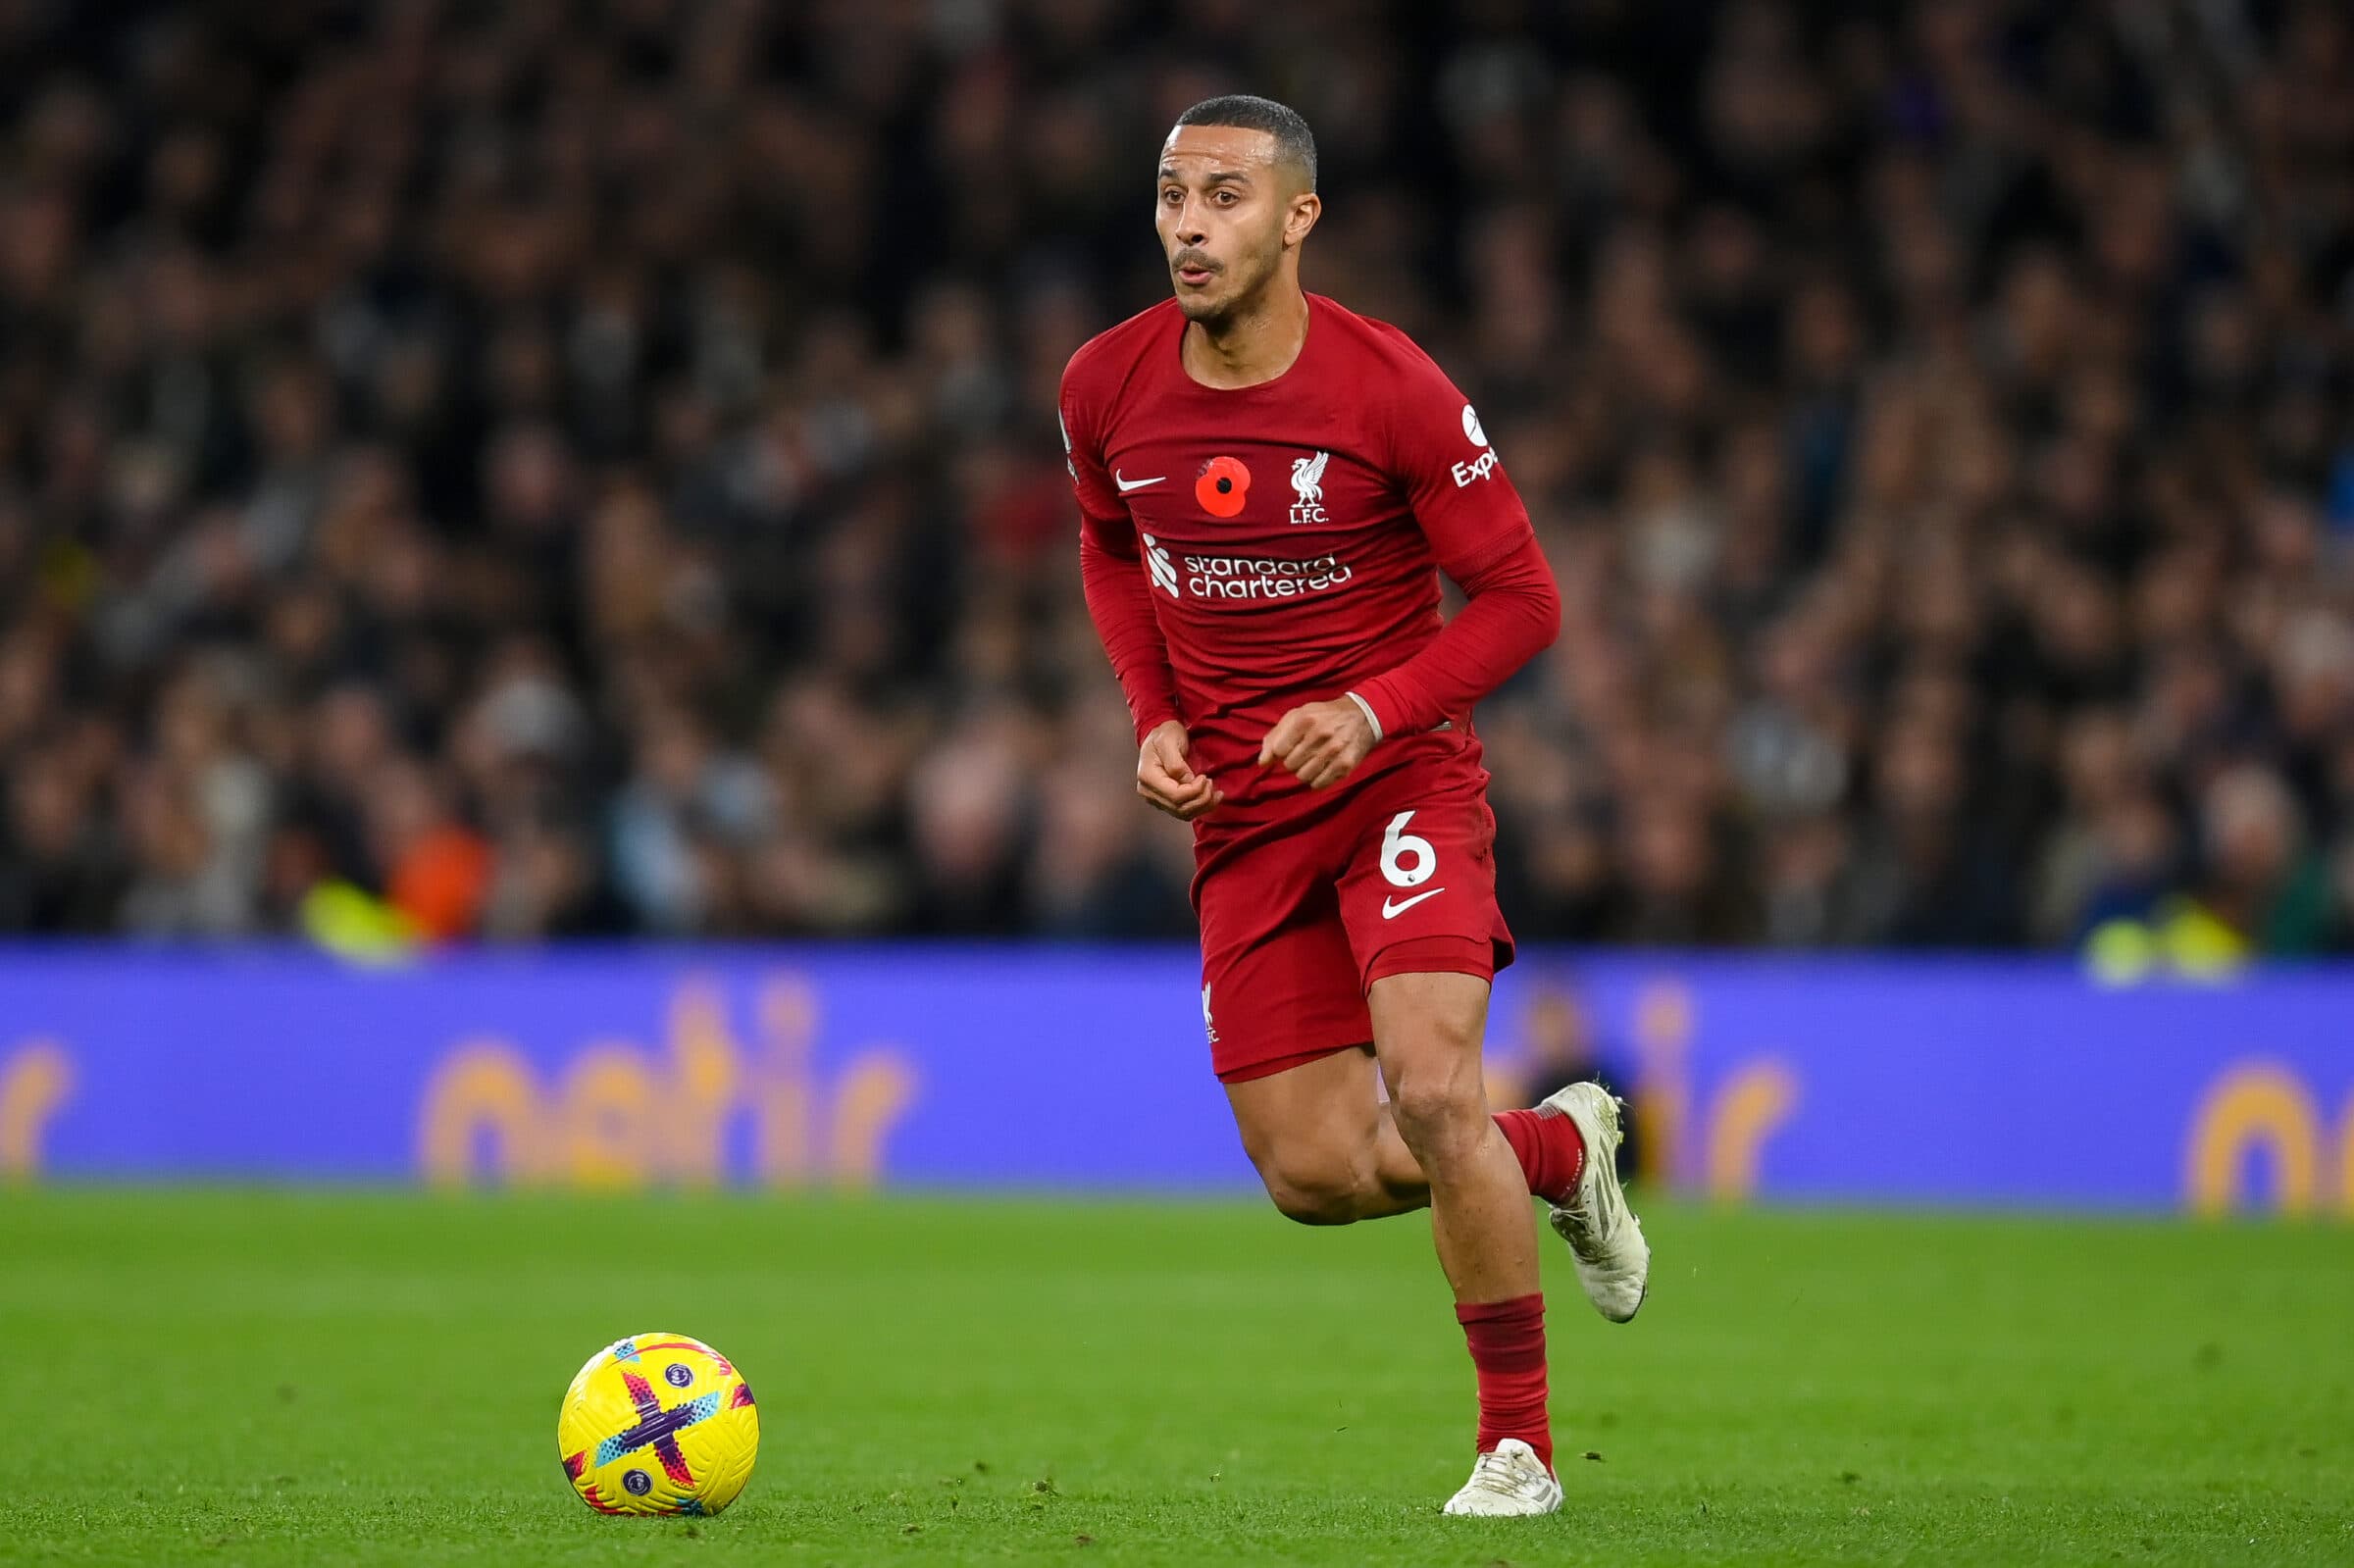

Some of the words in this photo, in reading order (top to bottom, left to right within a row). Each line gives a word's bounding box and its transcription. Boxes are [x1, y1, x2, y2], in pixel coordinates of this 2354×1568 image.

[1184, 553, 1336, 577] standard
[1189, 566, 1353, 598] chartered
[1379, 810, 1437, 887] 6
